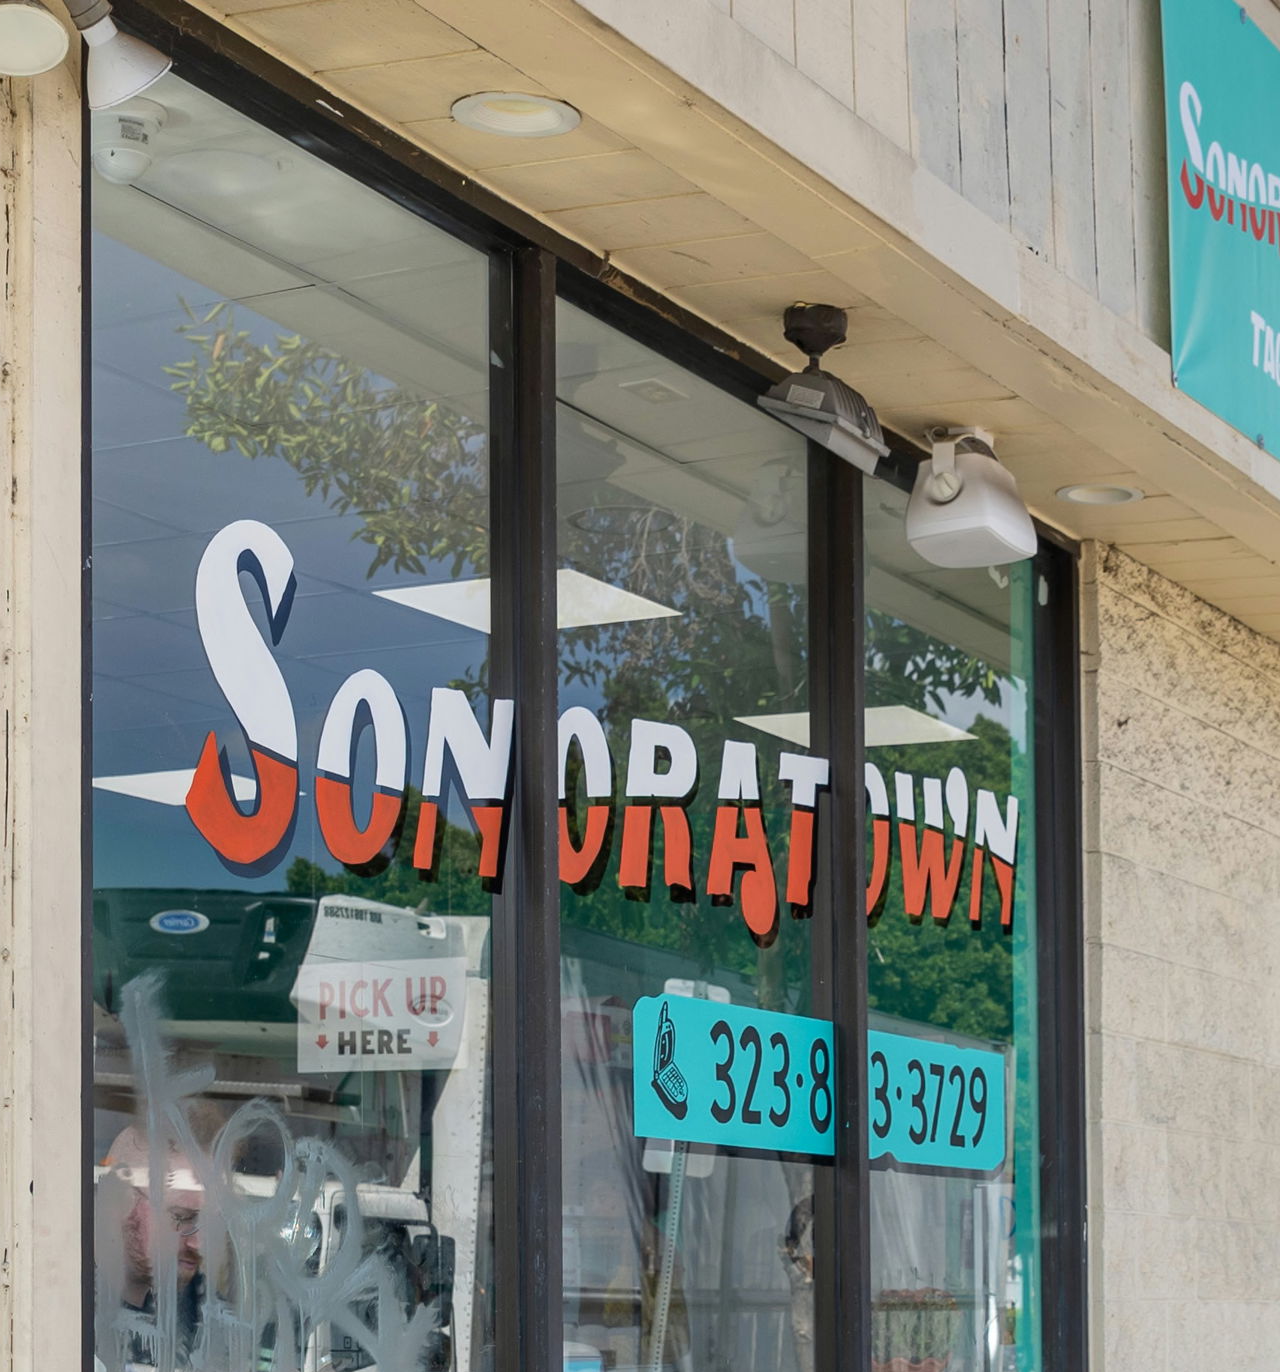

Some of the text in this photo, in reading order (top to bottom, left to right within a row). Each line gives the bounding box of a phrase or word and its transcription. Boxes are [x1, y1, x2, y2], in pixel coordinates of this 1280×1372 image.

[319, 975, 447, 1020] PICK UP
[337, 1029, 413, 1055] HERE
